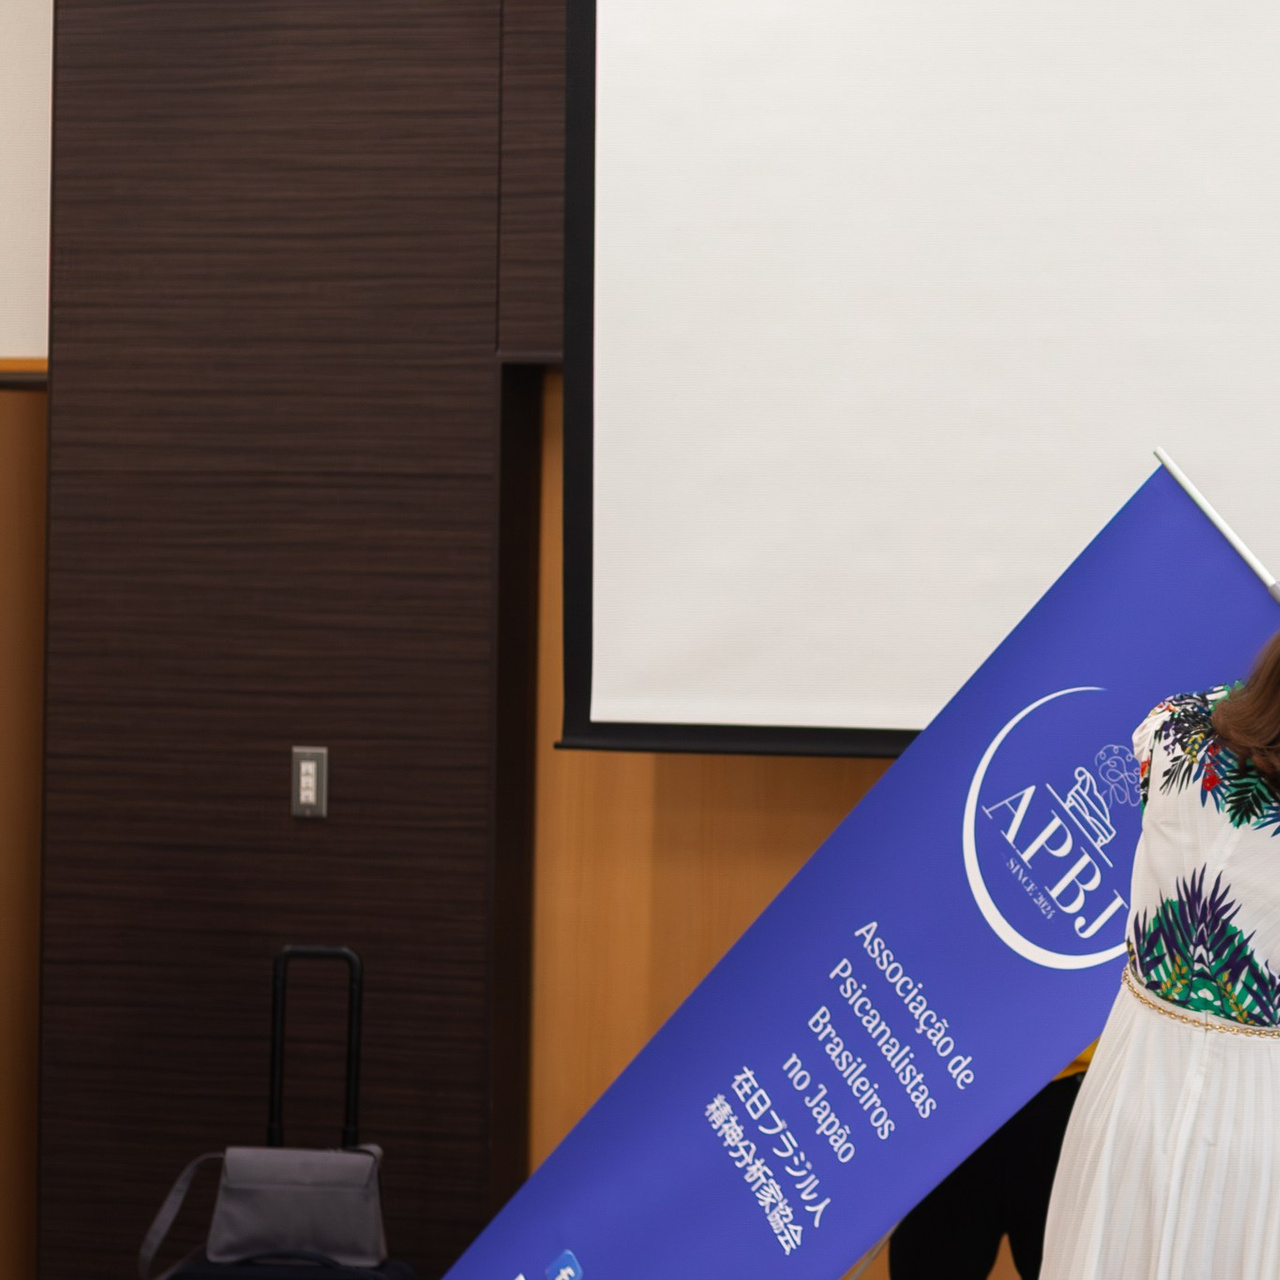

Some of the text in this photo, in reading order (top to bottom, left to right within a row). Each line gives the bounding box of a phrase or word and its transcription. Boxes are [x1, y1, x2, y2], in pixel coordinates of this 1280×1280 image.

[982, 785, 1128, 939] APBJ
[1006, 857, 1038, 897] SINCE
[808, 1005, 896, 1140] Brasileiros
[829, 958, 938, 1120] Psicanalistas
[854, 921, 976, 1090] Associação de
[704, 1093, 804, 1256] 精神分析家協会
[731, 1065, 832, 1228] 在日ブラジル人
[782, 1052, 856, 1164] no Japão
